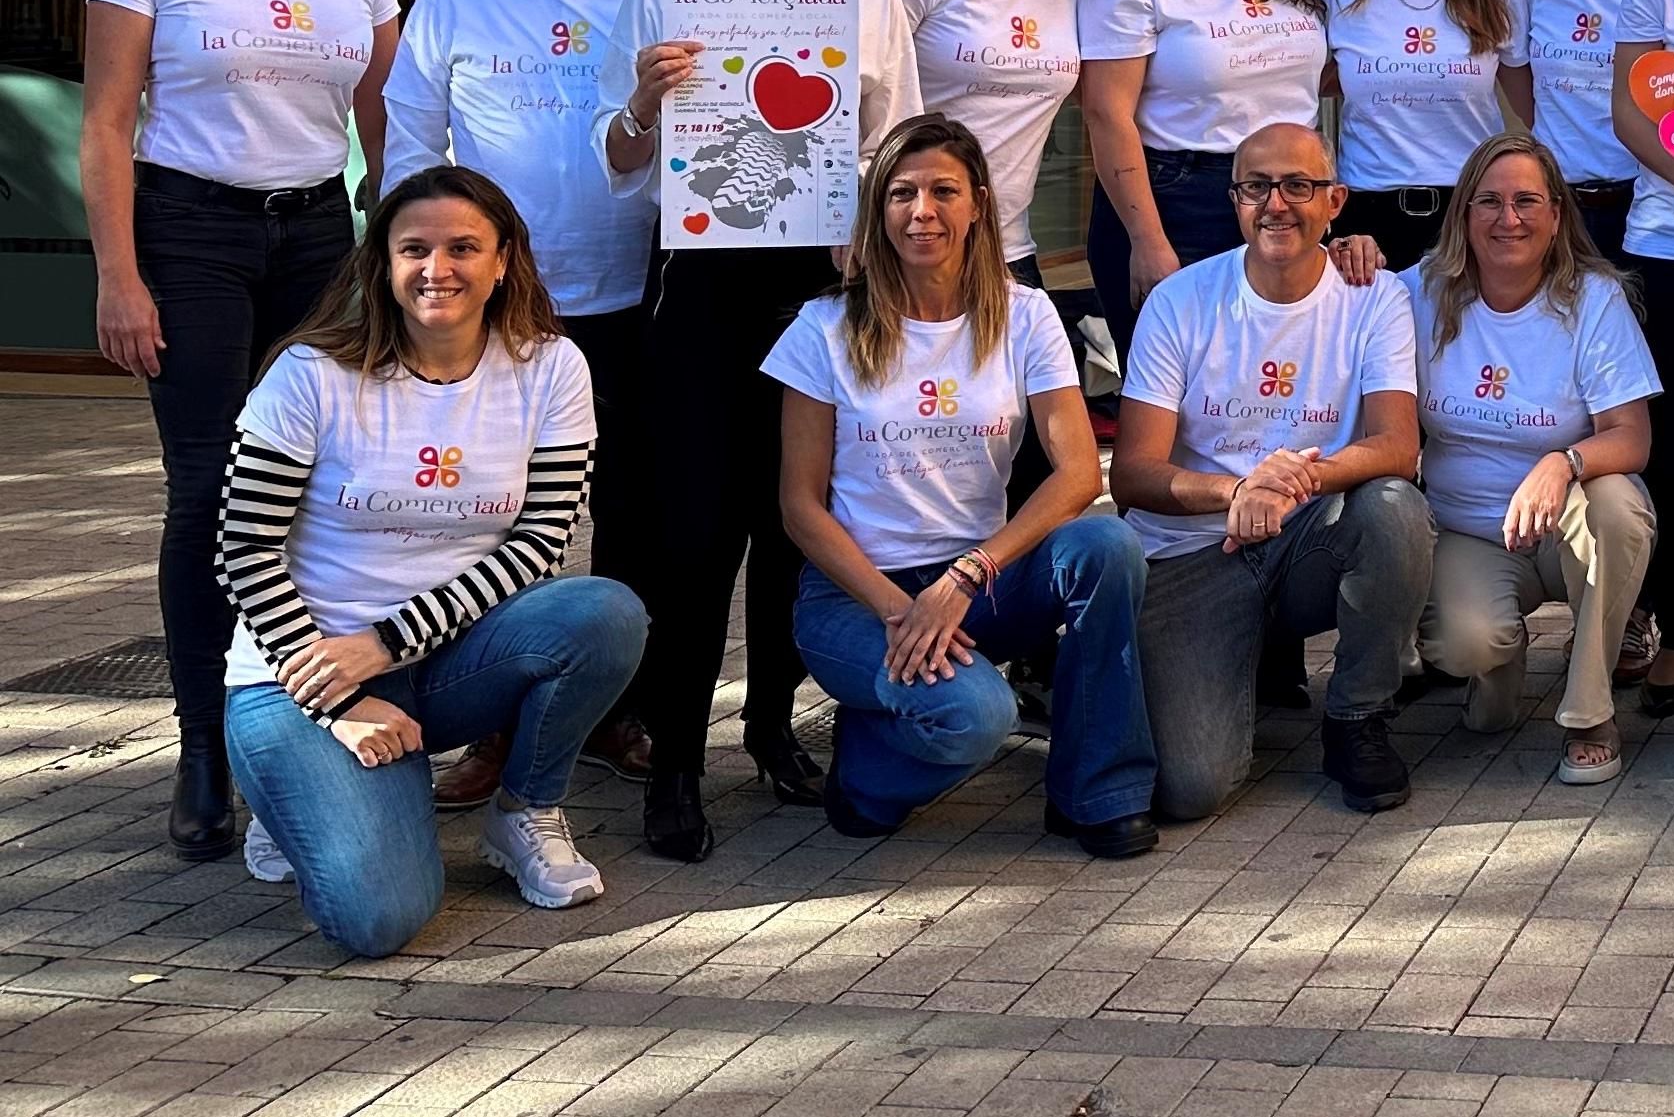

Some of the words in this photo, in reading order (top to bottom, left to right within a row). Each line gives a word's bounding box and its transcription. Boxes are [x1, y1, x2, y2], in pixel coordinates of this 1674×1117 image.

[201, 29, 227, 51] la
[1208, 21, 1229, 39] la
[1229, 16, 1319, 38] Comerçiada
[957, 43, 976, 64] la
[1543, 42, 1613, 68] Comerçi
[491, 54, 513, 74] la
[516, 53, 599, 83] Comerç
[1357, 56, 1373, 74] la
[1375, 55, 1482, 79] Comerçiada
[674, 124, 687, 134] 17,
[691, 124, 703, 133] 18
[712, 123, 724, 133] 19
[1202, 395, 1222, 417] la
[1225, 397, 1340, 428] Comerçiada
[1423, 389, 1438, 413] la
[1441, 395, 1558, 429] Comerçiada
[856, 421, 877, 443] la
[881, 416, 1009, 443] Comerçiada
[335, 483, 361, 512] la
[366, 488, 520, 520] Comerçiada
